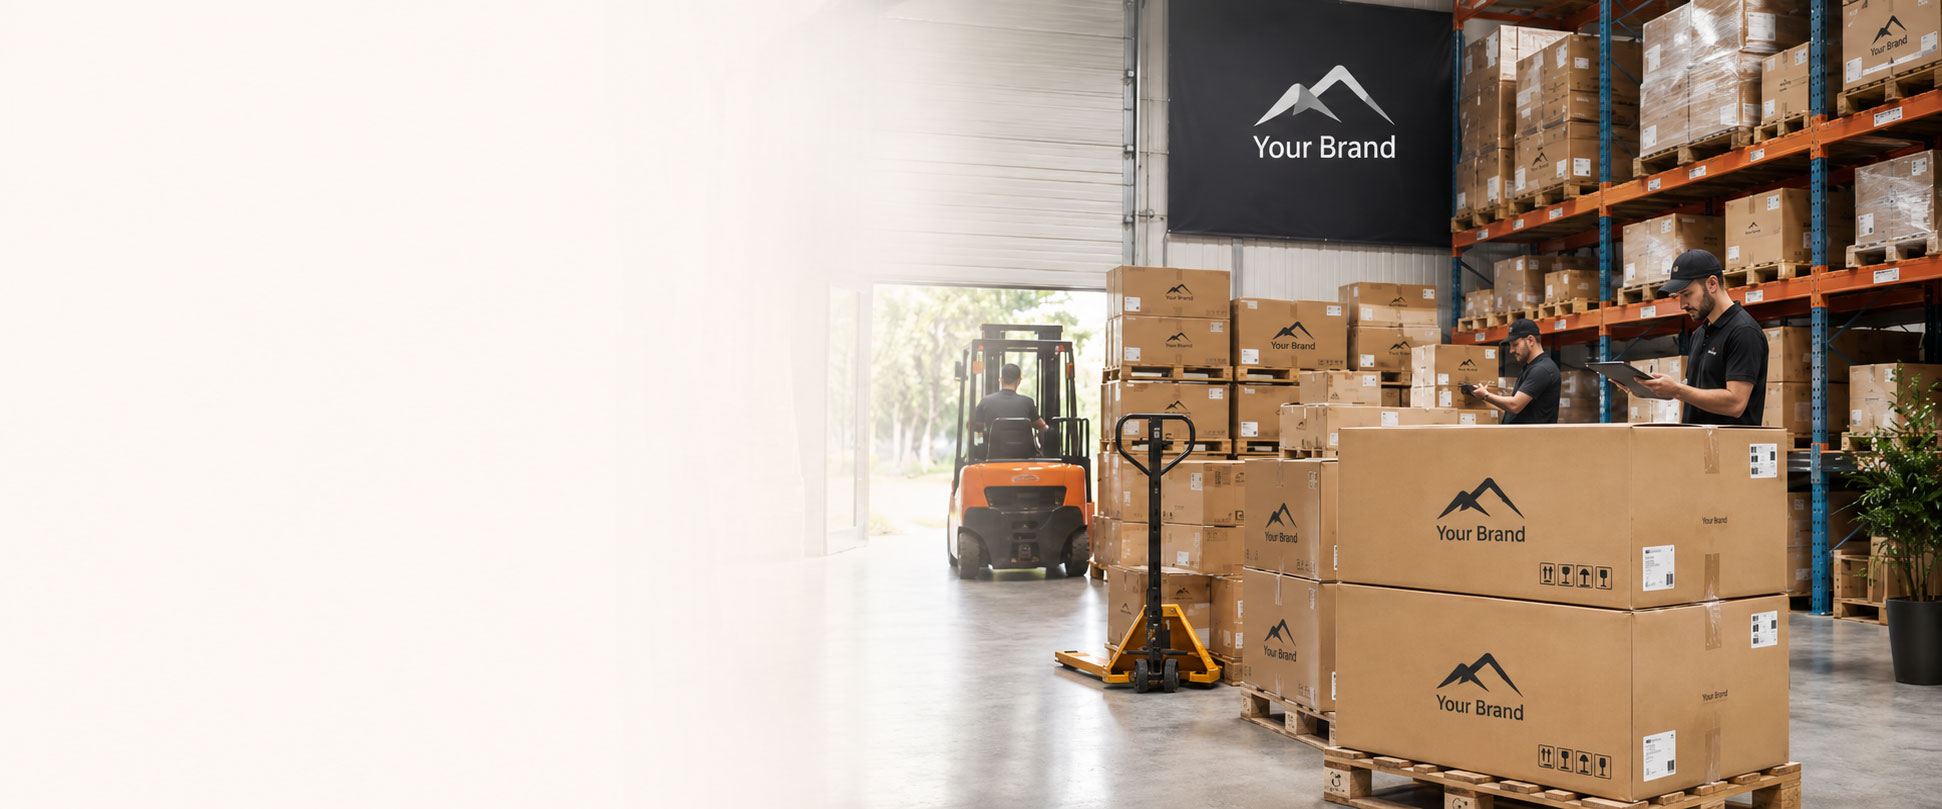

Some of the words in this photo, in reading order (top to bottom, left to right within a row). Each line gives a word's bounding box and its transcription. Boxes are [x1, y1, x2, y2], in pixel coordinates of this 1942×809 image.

[1870, 45, 1885, 57] Your
[1887, 34, 1908, 51] Brand
[1253, 135, 1313, 159] Your
[1320, 134, 1396, 159] Brand
[1271, 341, 1289, 350] Your
[1291, 341, 1316, 350] Brand
[1264, 531, 1278, 542] Your
[1279, 532, 1298, 543] Brand
[1436, 525, 1472, 541] Your
[1477, 525, 1525, 542] Brand
[1264, 645, 1277, 658] Your
[1278, 648, 1297, 662] Brand
[1436, 694, 1471, 714] Your
[1476, 699, 1524, 721] Brand
